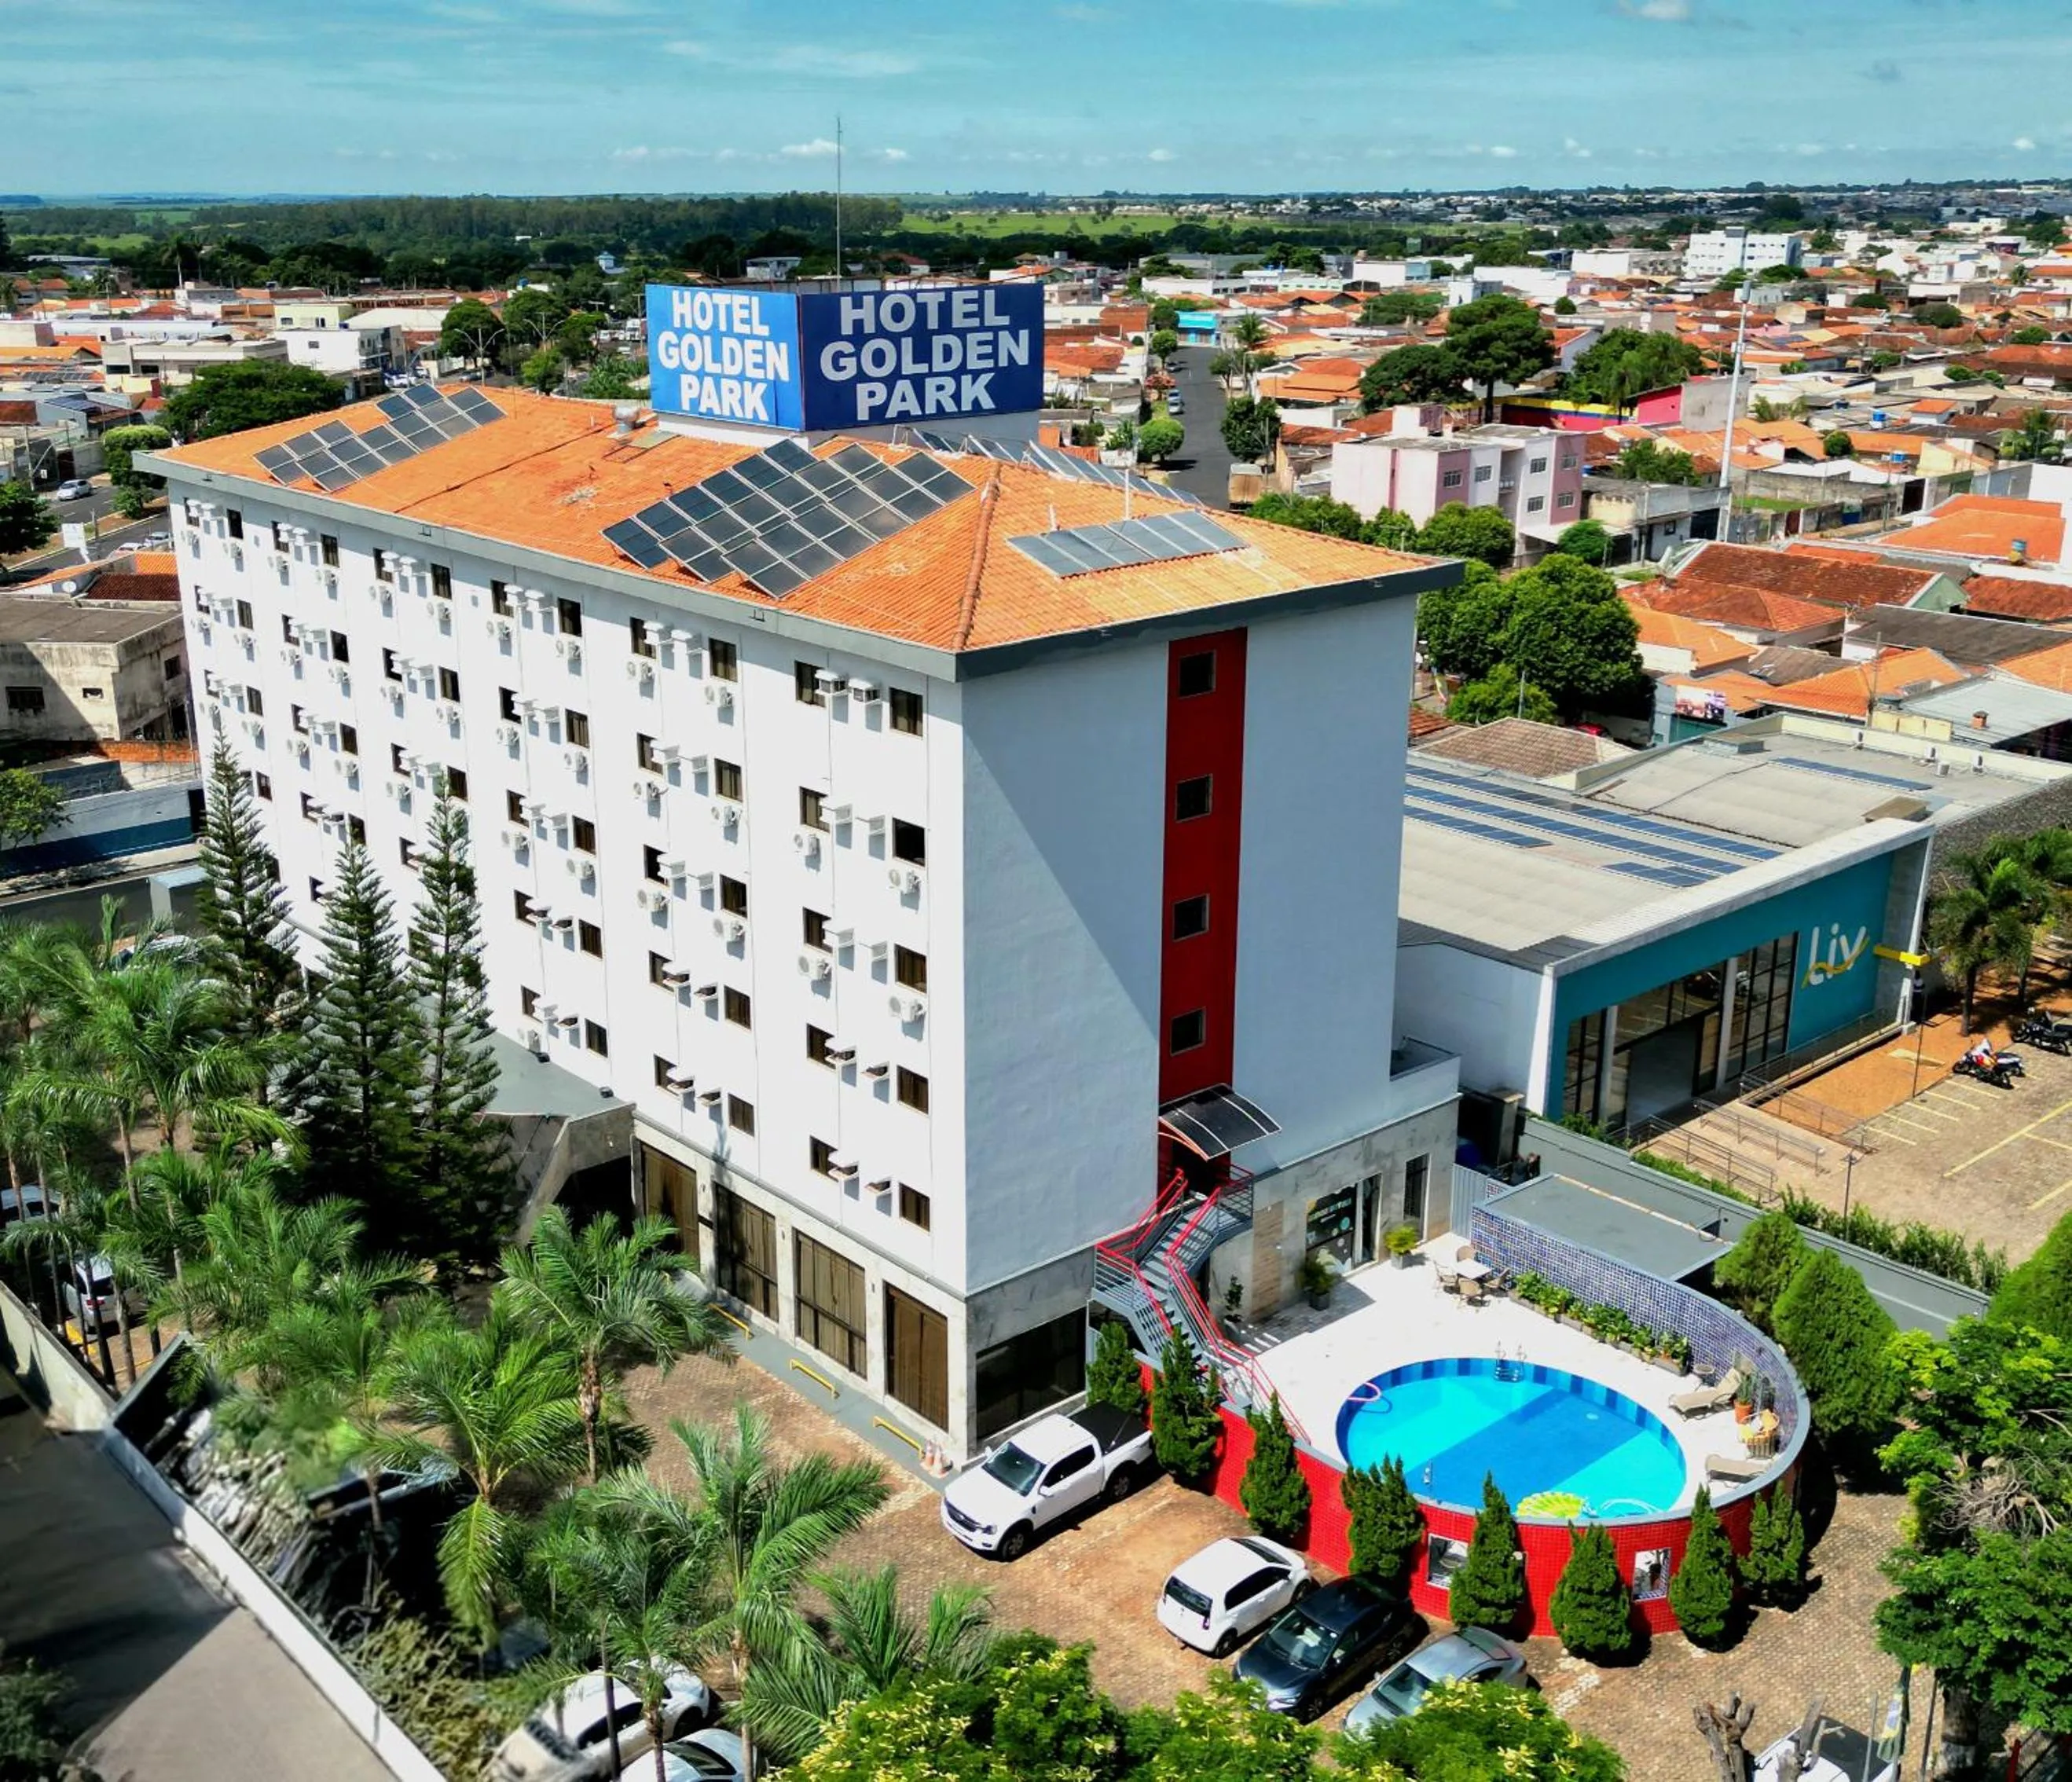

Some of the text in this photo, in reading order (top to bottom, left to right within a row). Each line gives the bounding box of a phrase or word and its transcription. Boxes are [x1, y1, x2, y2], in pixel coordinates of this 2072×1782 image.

[672, 290, 770, 336] HOTEL
[840, 289, 1011, 336] HOTEL
[658, 331, 789, 383] GOLDEN
[820, 328, 1030, 381] GOLDEN
[680, 374, 769, 421] PARK
[856, 372, 997, 420] PARK
[1809, 922, 1867, 986] Liv
